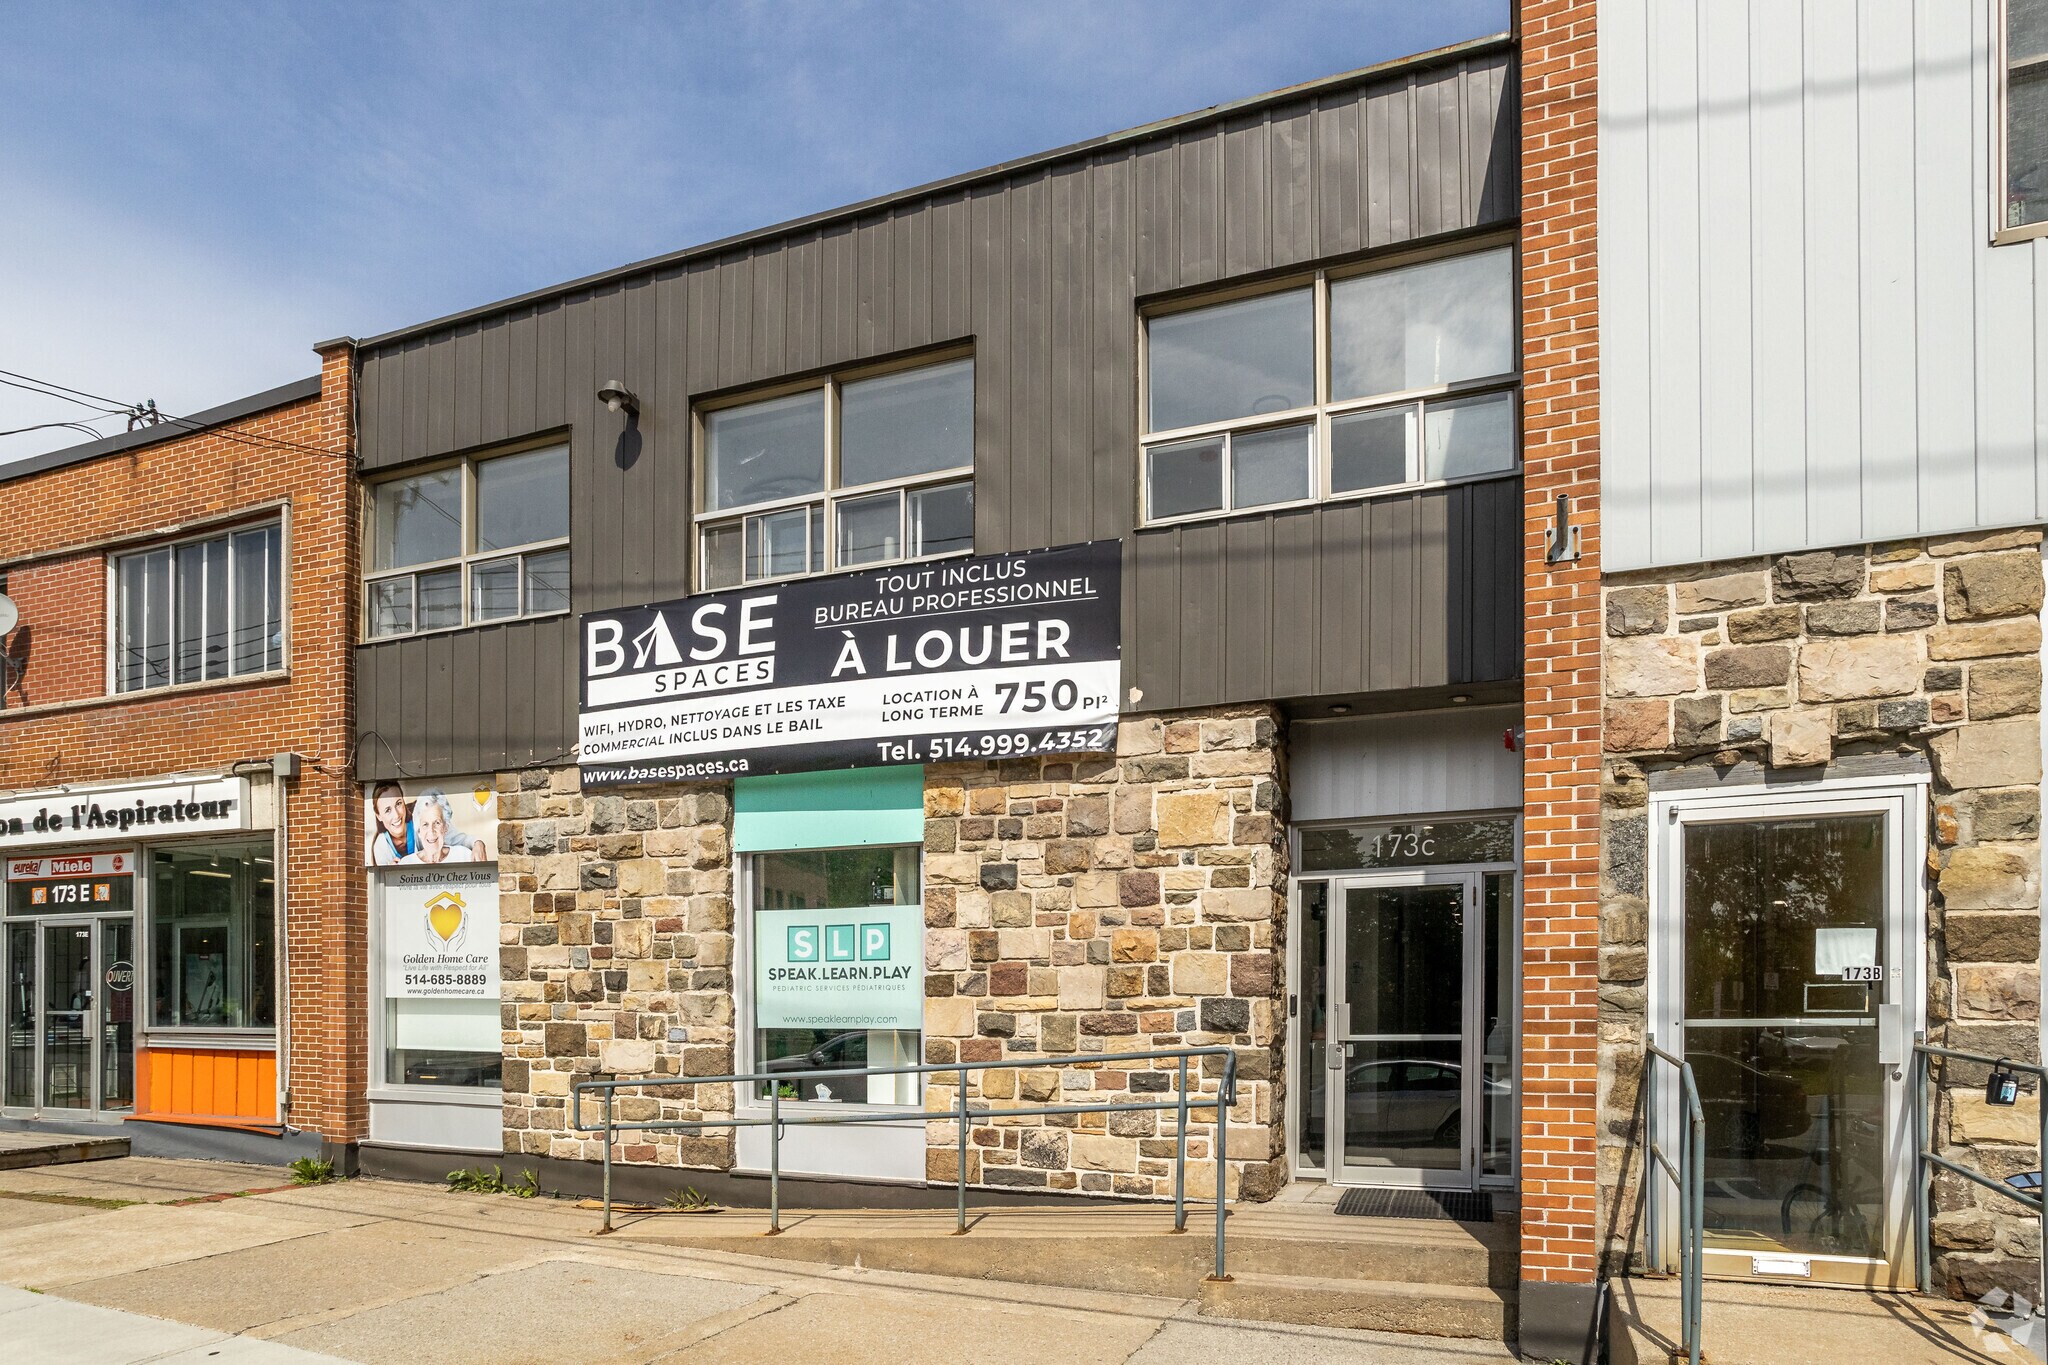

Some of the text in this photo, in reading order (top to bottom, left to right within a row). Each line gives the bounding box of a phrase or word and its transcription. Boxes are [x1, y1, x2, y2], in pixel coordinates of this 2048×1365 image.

[876, 560, 1027, 594] TOUT INCLUS
[814, 577, 1097, 624] BUREAU PROFESSIONNEL
[587, 594, 778, 677] BASE
[831, 619, 1070, 677] À LOUER
[654, 661, 769, 693] SPACES
[883, 684, 979, 705] LOCATION À
[995, 679, 1078, 714] 750
[584, 696, 846, 737] WIFI, HYDRO, NETTOYAGE ET LES TAXE
[882, 704, 984, 723] LONG TERME
[584, 718, 823, 755] COMMERCIAL INCLUS DANS LE BAIL
[877, 728, 1103, 762] Tel. 514.999.4352
[583, 758, 749, 783] www.basespaces.ca
[33, 808, 62, 832] de
[71, 799, 232, 831] l'Aspirateur
[52, 859, 92, 874] Miele
[399, 871, 492, 884] Soins d'Or Chez Vous
[52, 884, 90, 903] 173 E
[403, 954, 489, 964] Golden Home Care
[405, 973, 487, 985] 514-685-8889
[768, 965, 912, 981] SPEAK.LEARN.PLAY
[1844, 967, 1881, 980] 173B
[407, 987, 485, 995] www.goldenhomecare.ca
[782, 1015, 898, 1025] www.speaklearnplay.com
